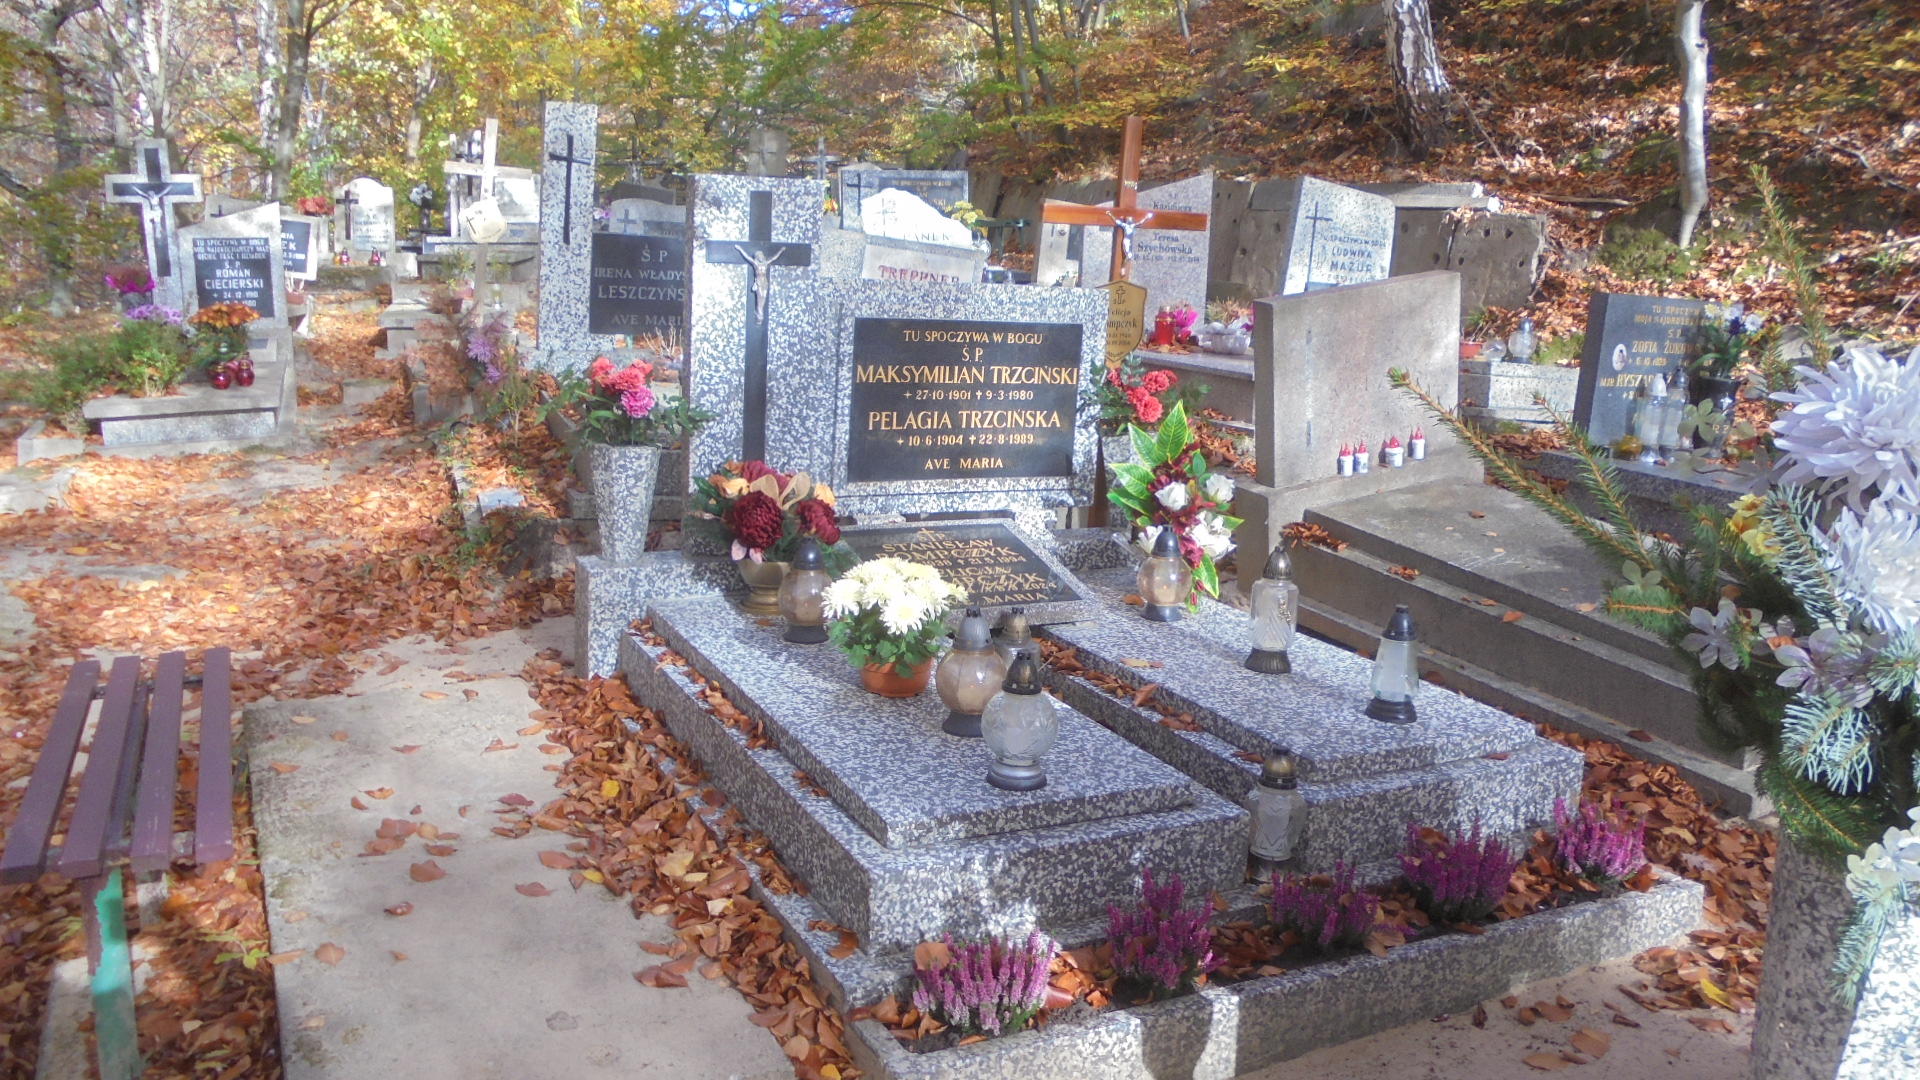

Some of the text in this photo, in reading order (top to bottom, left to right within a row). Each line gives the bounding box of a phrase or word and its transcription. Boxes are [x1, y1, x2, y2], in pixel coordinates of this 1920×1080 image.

[1153, 232, 1180, 242] Teresa
[1137, 241, 1194, 255] Szychowska
[215, 269, 251, 278] ROMAN
[594, 268, 633, 279] IRENA
[205, 278, 265, 289] CIECIERSKI
[598, 284, 685, 301] LESZCZYŃS
[611, 314, 683, 327] AVE MARI
[903, 330, 1043, 345] TU SPOCZYWA W BOGU
[1631, 340, 1658, 353] ZOFIA
[856, 365, 1078, 385] MAKSYMILIAN TRZCIŃSKI
[868, 409, 1061, 431] PELAGIA TRZCIŃSKA
[924, 457, 1004, 471] AVE MARIA
[882, 538, 994, 552] STANISŁAW
[983, 592, 1050, 605] MARIA
